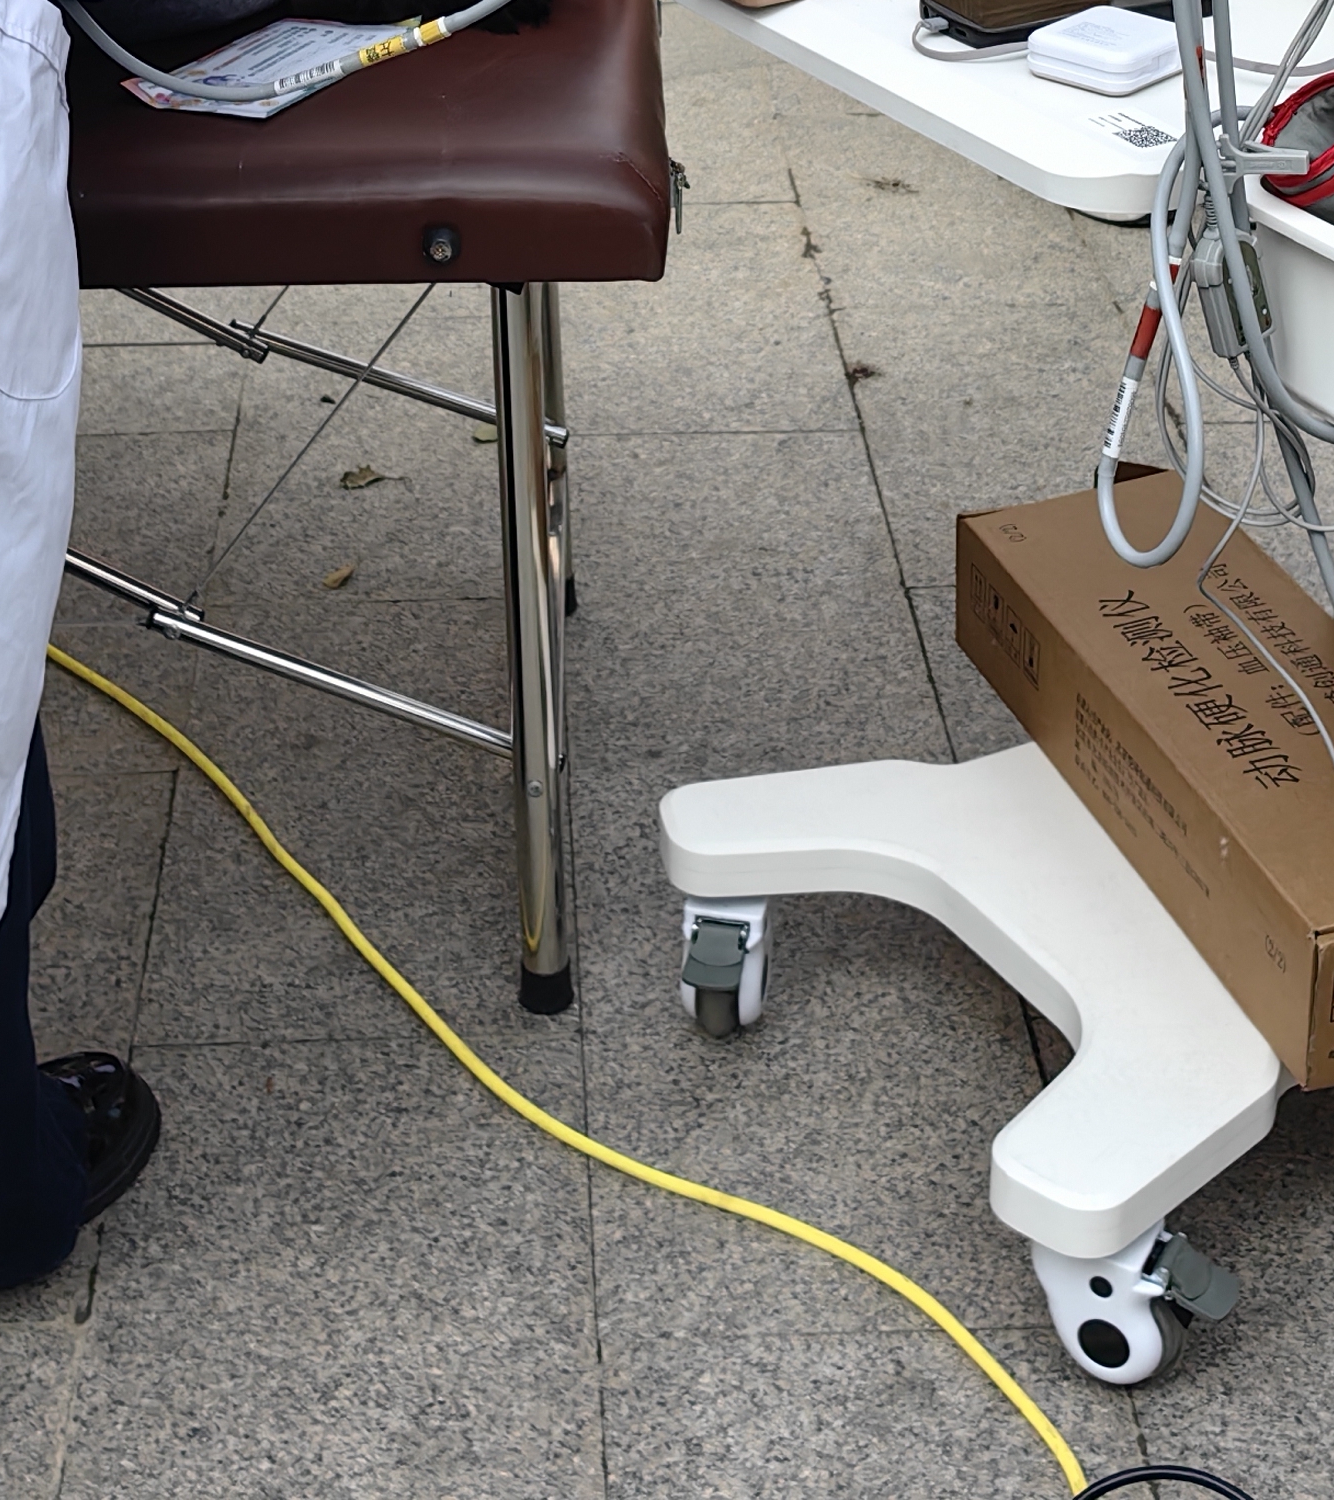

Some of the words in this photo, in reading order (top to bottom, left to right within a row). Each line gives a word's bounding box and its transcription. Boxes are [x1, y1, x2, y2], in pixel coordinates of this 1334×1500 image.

[1098, 588, 1302, 791] 动脉硬化检测仪
